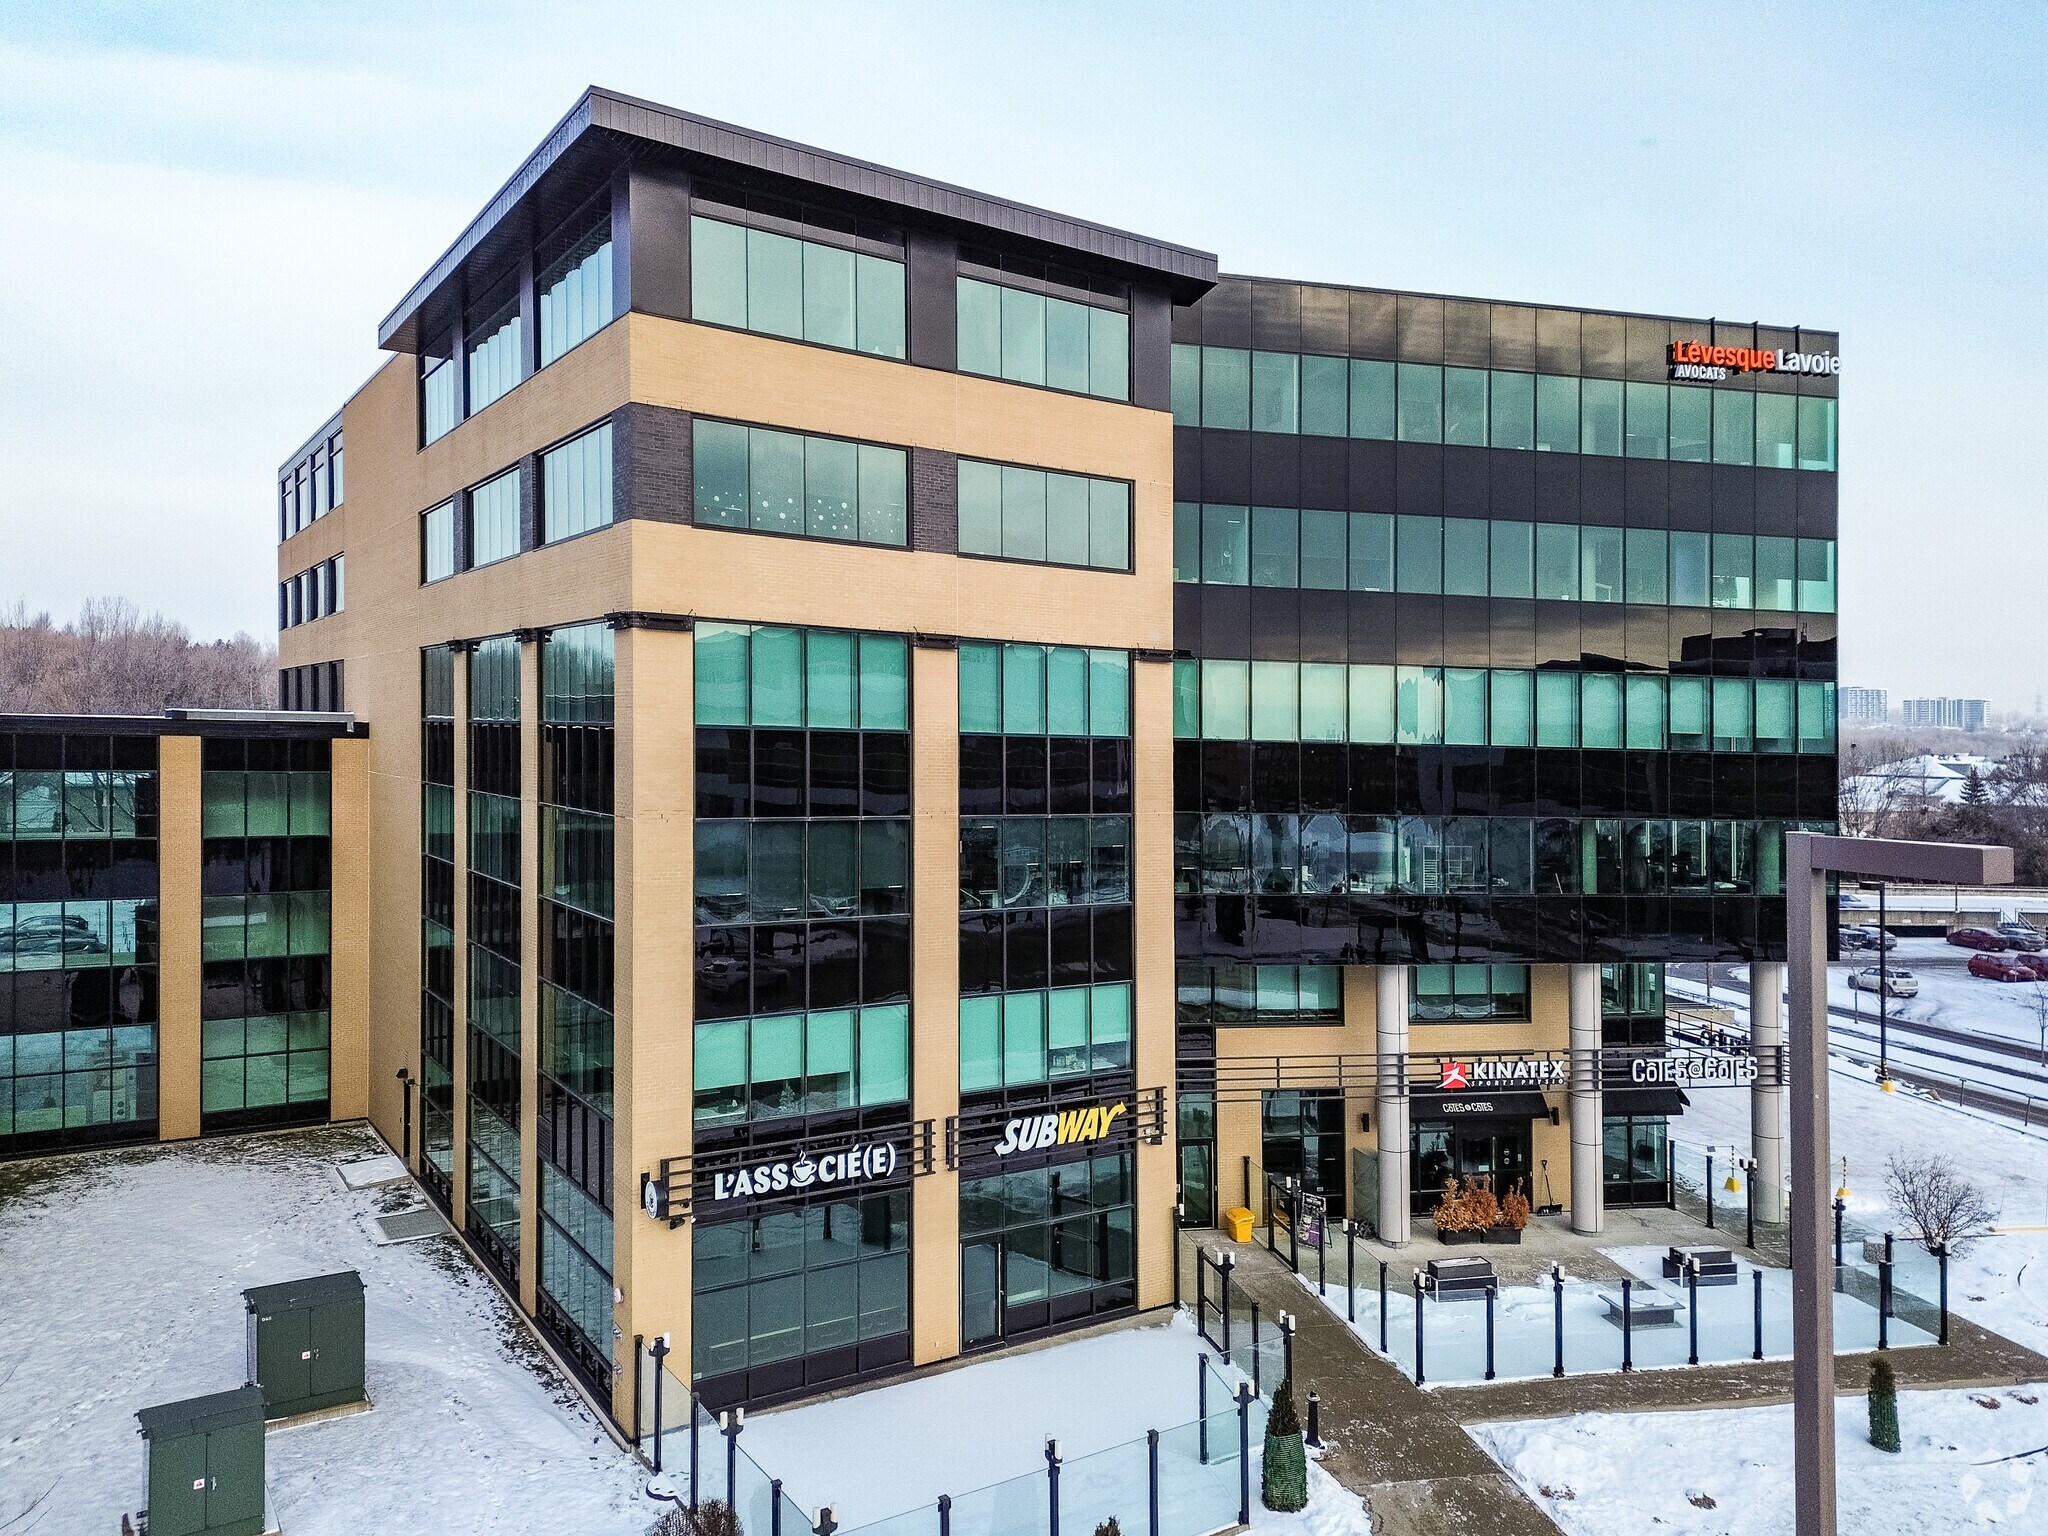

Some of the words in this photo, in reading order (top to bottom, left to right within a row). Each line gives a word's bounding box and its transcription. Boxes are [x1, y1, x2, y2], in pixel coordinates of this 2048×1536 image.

[1675, 366, 1726, 380] AVOCATS
[1473, 1060, 1565, 1080] KINATEX
[1521, 1078, 1563, 1086] PHYSIO
[994, 1101, 1127, 1157] SUBWAY
